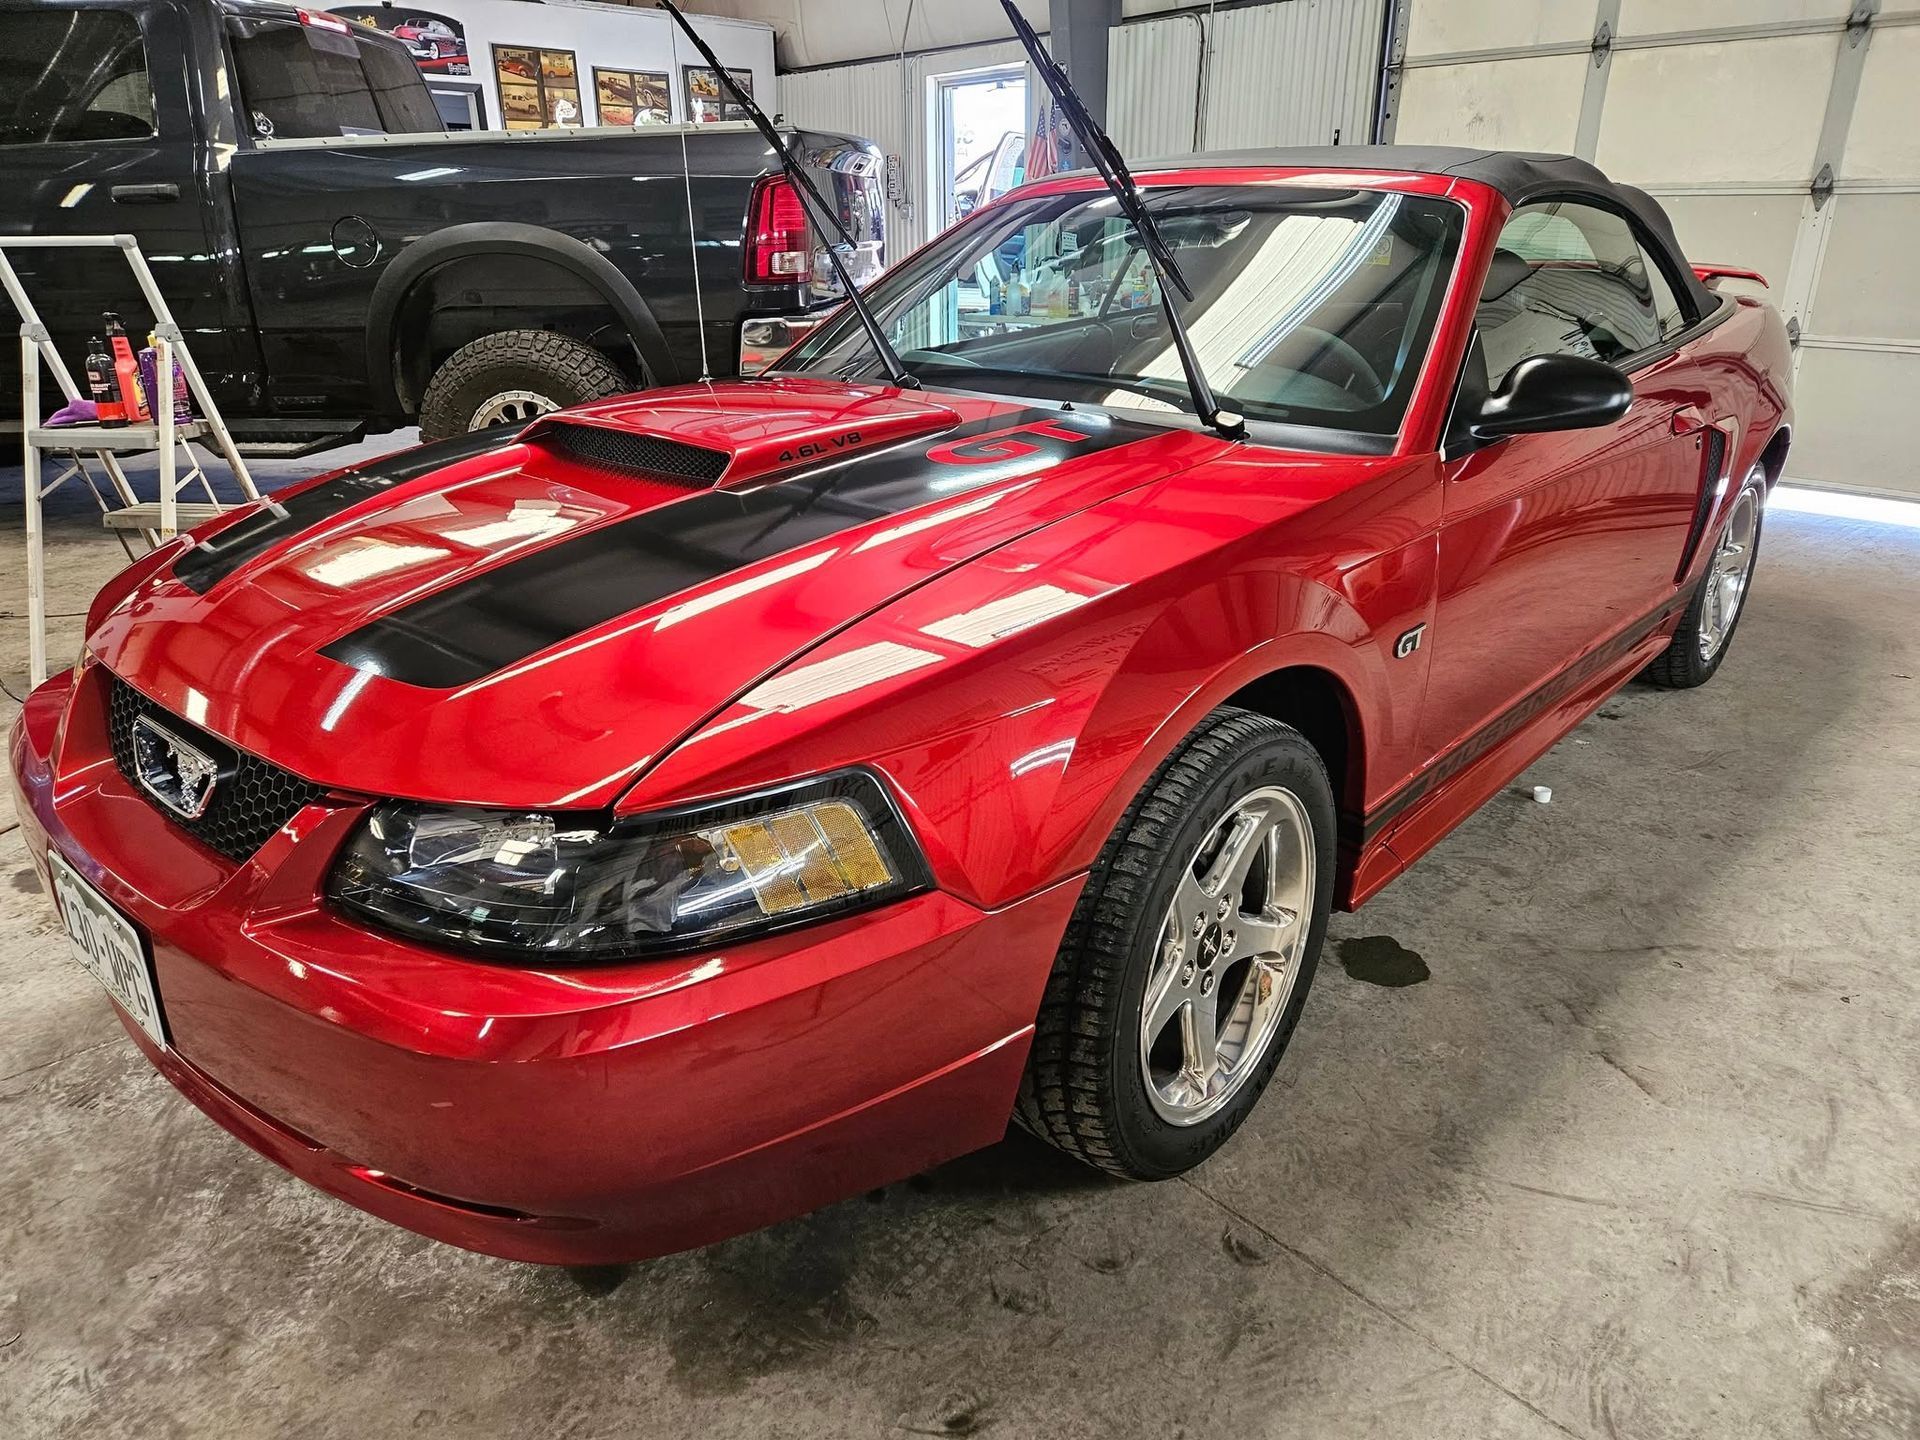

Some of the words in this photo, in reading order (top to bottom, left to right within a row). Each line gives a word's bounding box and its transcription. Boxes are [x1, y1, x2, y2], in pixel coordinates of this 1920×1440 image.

[779, 443, 828, 462] 4.6L
[830, 432, 862, 447] V8
[926, 419, 1092, 465] GT
[1394, 623, 1427, 658] GT
